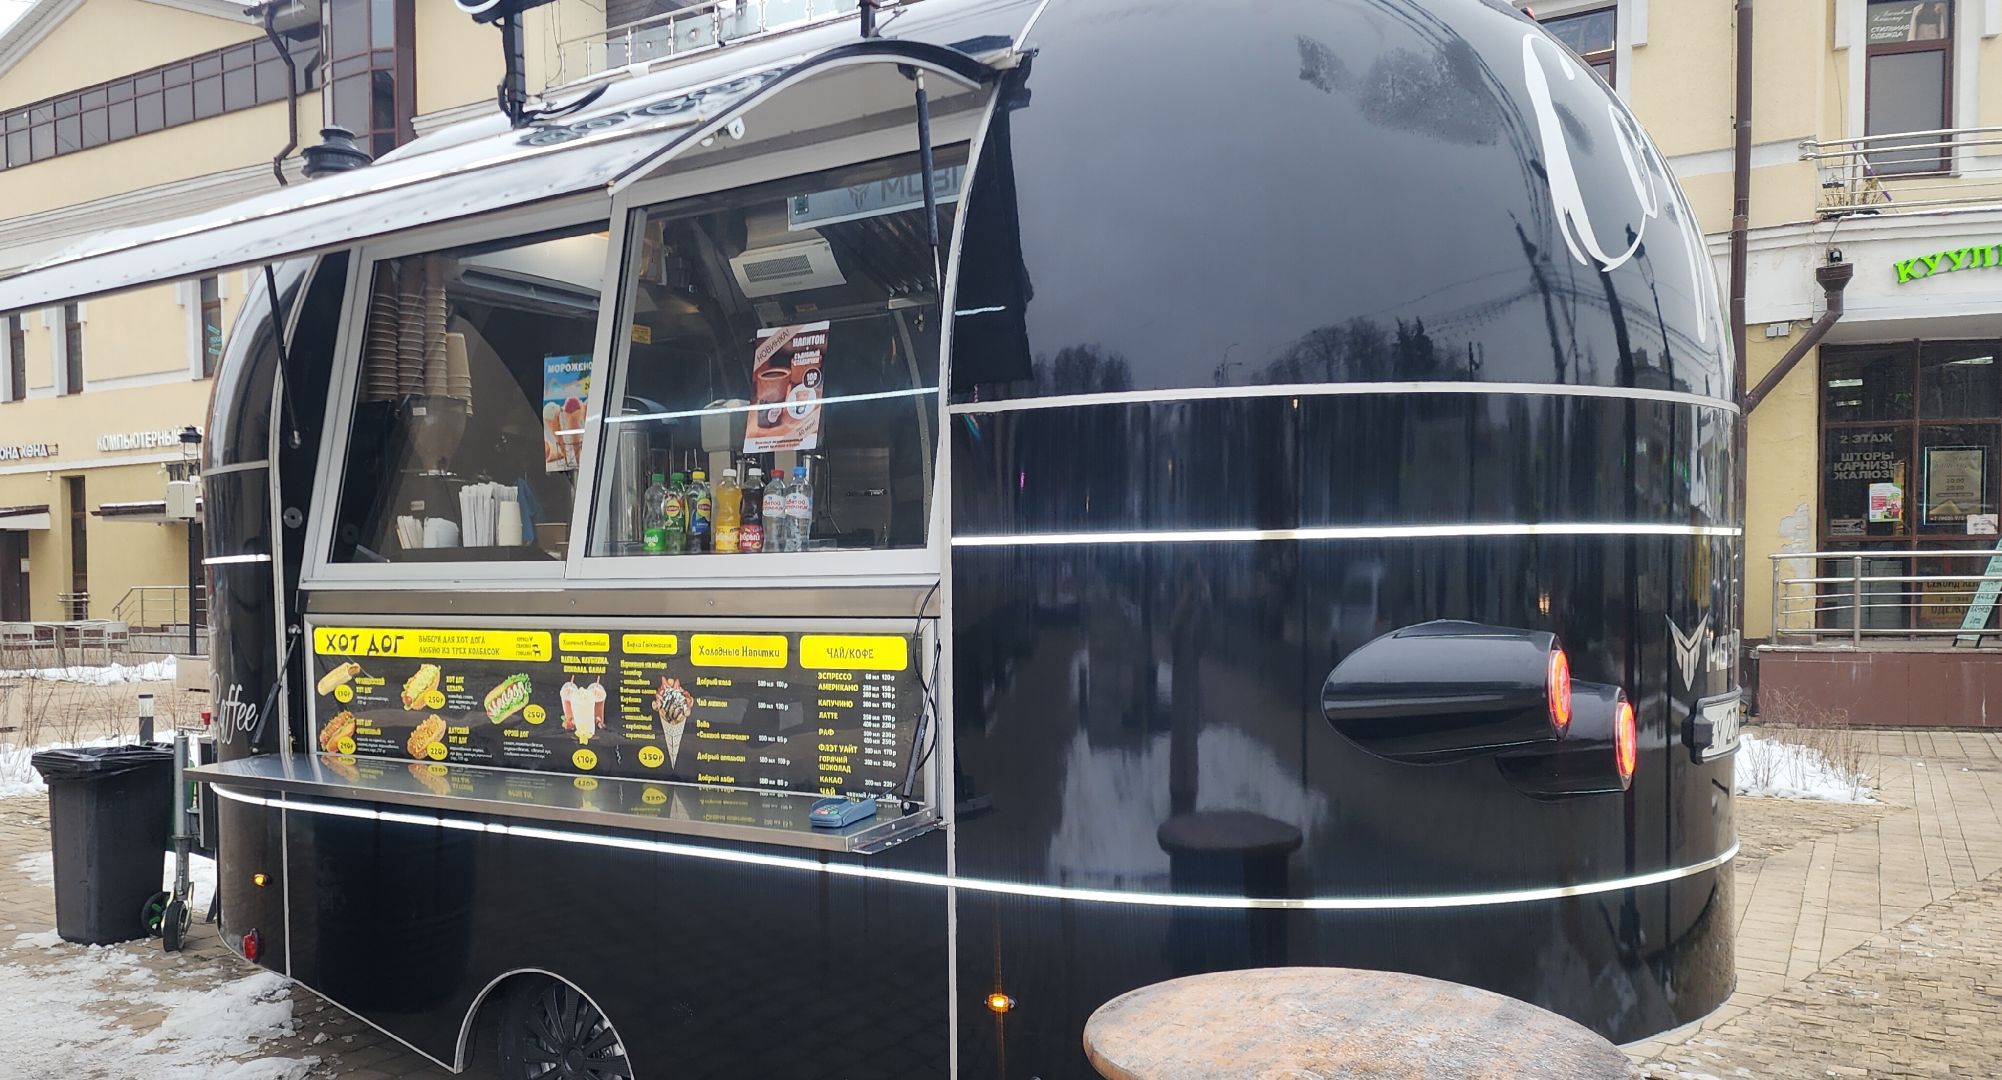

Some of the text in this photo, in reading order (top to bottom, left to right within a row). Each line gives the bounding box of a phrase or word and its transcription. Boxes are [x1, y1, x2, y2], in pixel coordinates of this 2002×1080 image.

[1893, 243, 2002, 285] КУУЛ
[757, 328, 791, 363] НОВИНКА!
[1840, 433, 1893, 444] 2 ЭТАЖ
[1841, 451, 1894, 462] ШТОРЫ
[326, 634, 404, 656] ХОТ ДОГ
[418, 635, 441, 643] ВЫБЕРИ
[456, 636, 469, 644] ХОТ
[470, 636, 486, 645] ДОГА
[468, 648, 500, 656] КОЛБАСОК
[698, 645, 780, 657] Холодные Напитки
[826, 646, 874, 659] ЧАЙ/КОФЕ
[817, 672, 853, 681] ЭСПРЕССО
[818, 683, 859, 691] АМЕРИКАНО
[818, 699, 854, 708] КАПУЧИНО
[818, 712, 838, 720] ЛАТТЕ
[818, 728, 835, 736] РАФ
[818, 743, 838, 752] ФЛЭТ
[839, 744, 858, 754] УАЙТ
[818, 755, 848, 764] ГОРЯЧИЙ
[818, 764, 852, 774] ШОКОЛАД
[819, 776, 843, 785] КАКАО
[820, 787, 836, 796] ЧАЙ
